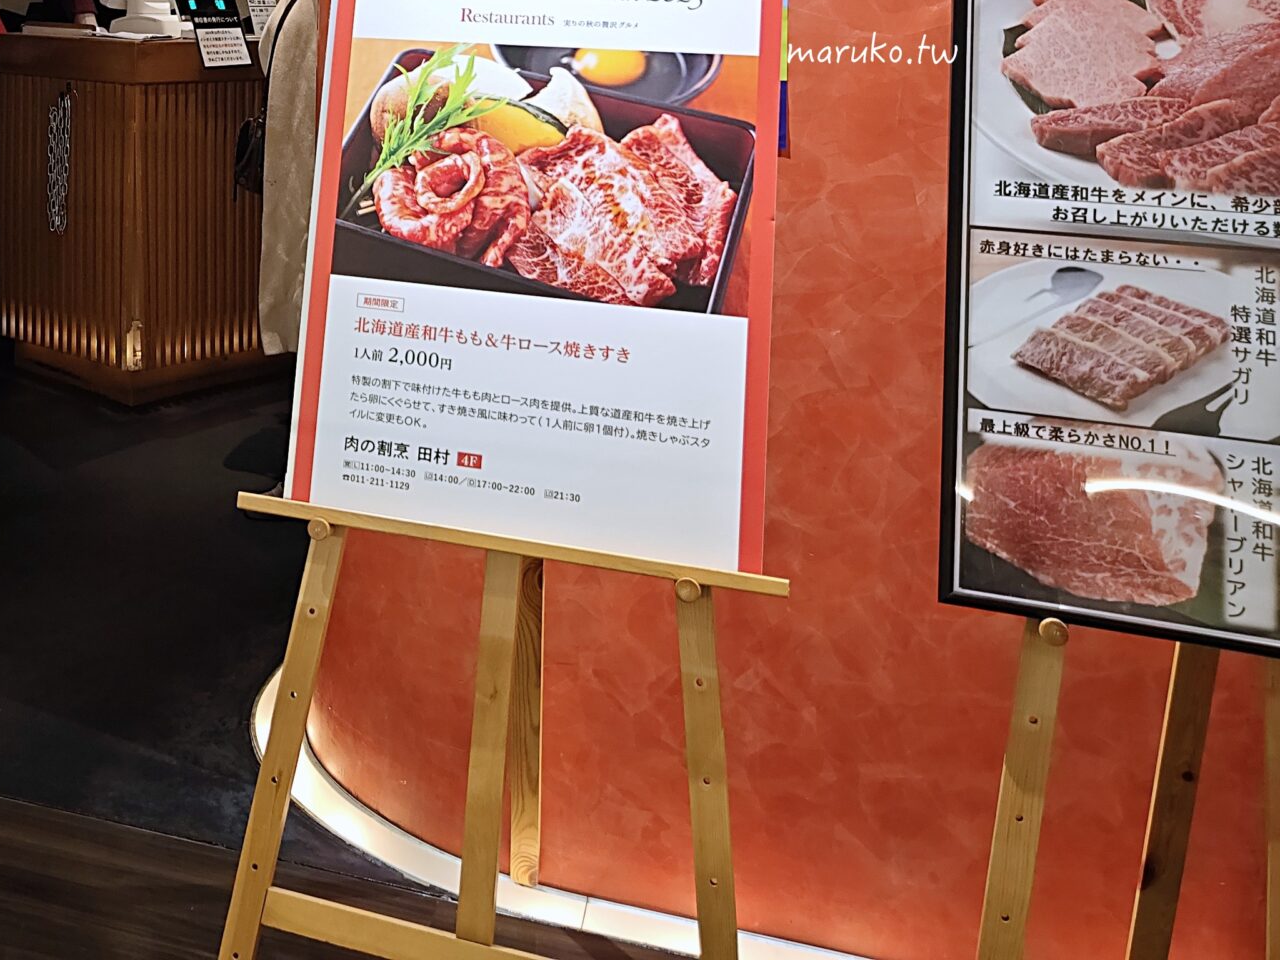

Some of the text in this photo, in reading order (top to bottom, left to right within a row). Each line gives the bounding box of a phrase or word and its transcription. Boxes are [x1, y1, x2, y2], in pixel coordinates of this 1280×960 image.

[460, 7, 556, 26] Restaurants
[363, 296, 399, 309] 期間限定
[1254, 266, 1278, 367] 北海道和牛
[353, 346, 452, 371] 1人前 2,000円
[1230, 304, 1252, 406] 特選サガリ
[348, 408, 427, 429] イルに変更もOK。
[344, 435, 478, 467] 肉の割烹 田村 4F
[1226, 453, 1247, 618] シャーブリアン
